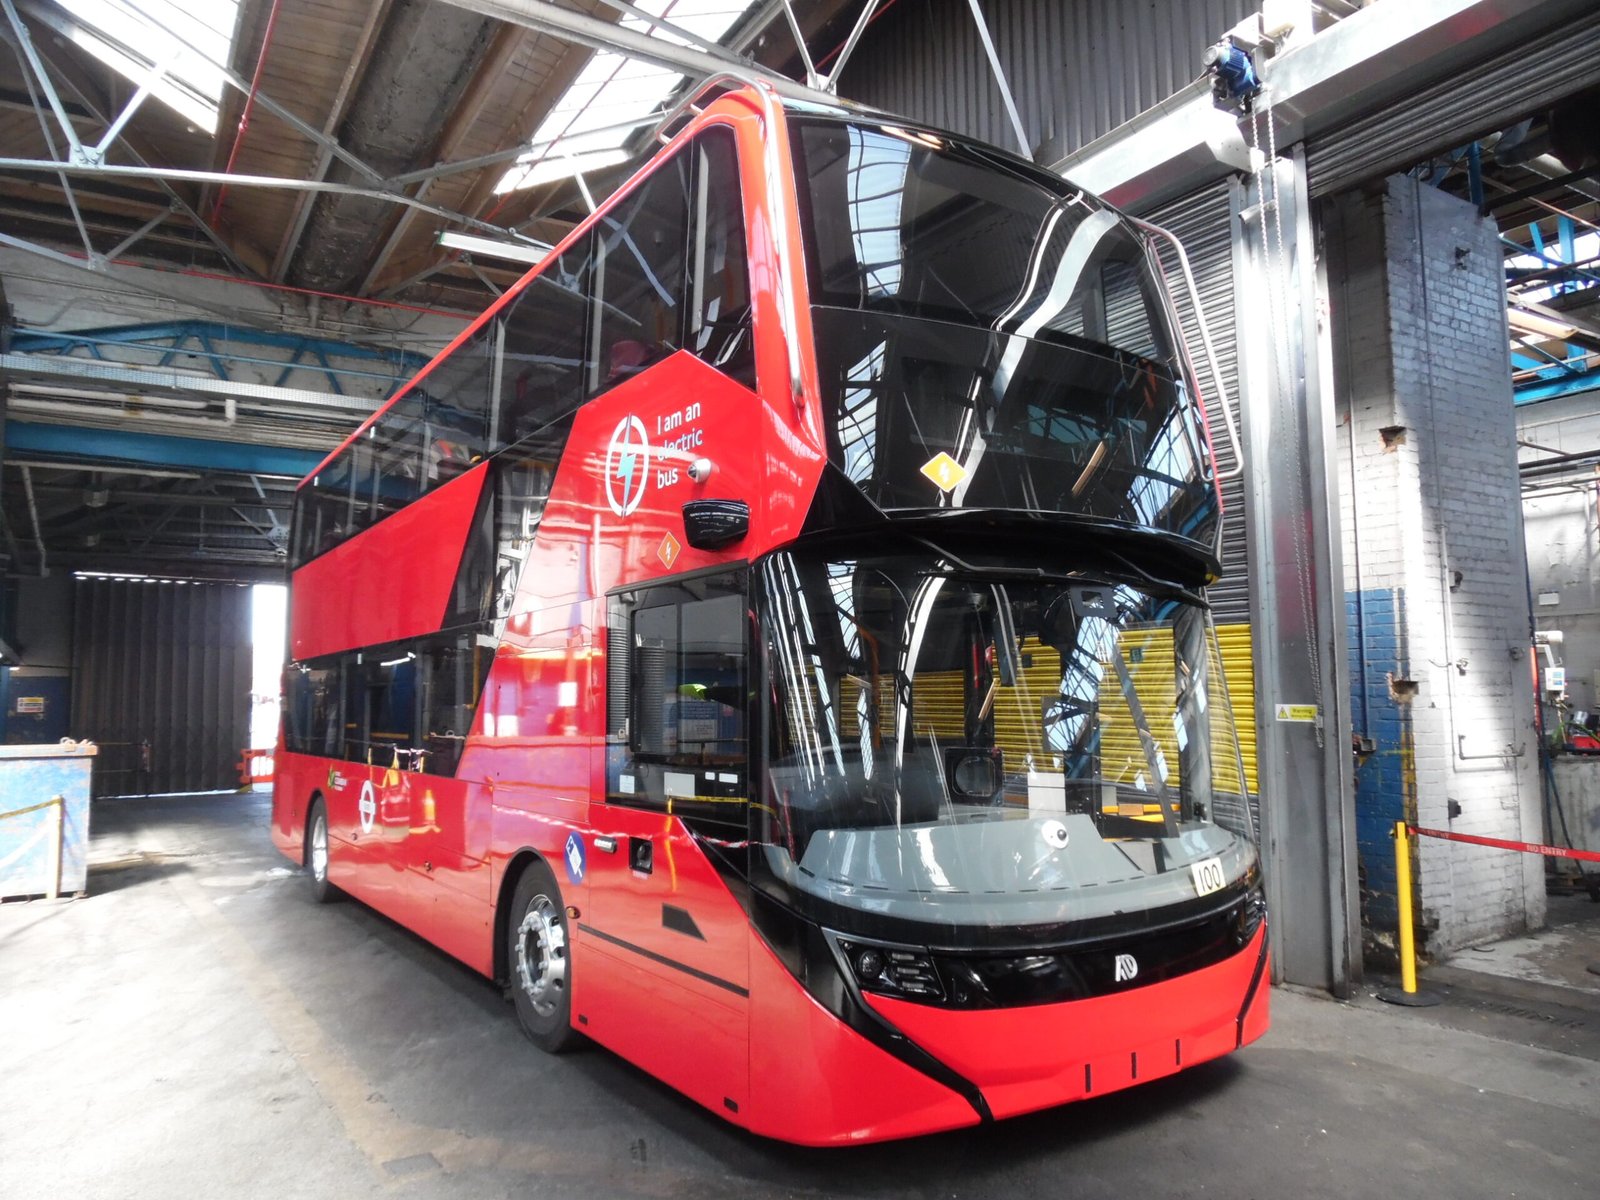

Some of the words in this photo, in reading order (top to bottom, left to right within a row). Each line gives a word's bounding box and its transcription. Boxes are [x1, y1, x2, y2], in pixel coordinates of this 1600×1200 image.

[657, 415, 662, 435] I
[664, 410, 682, 432] am
[685, 402, 701, 422] an
[657, 468, 679, 489] bus
[1526, 844, 1538, 852] NO
[1540, 846, 1567, 856] ENTRY
[1199, 864, 1221, 891] 100
